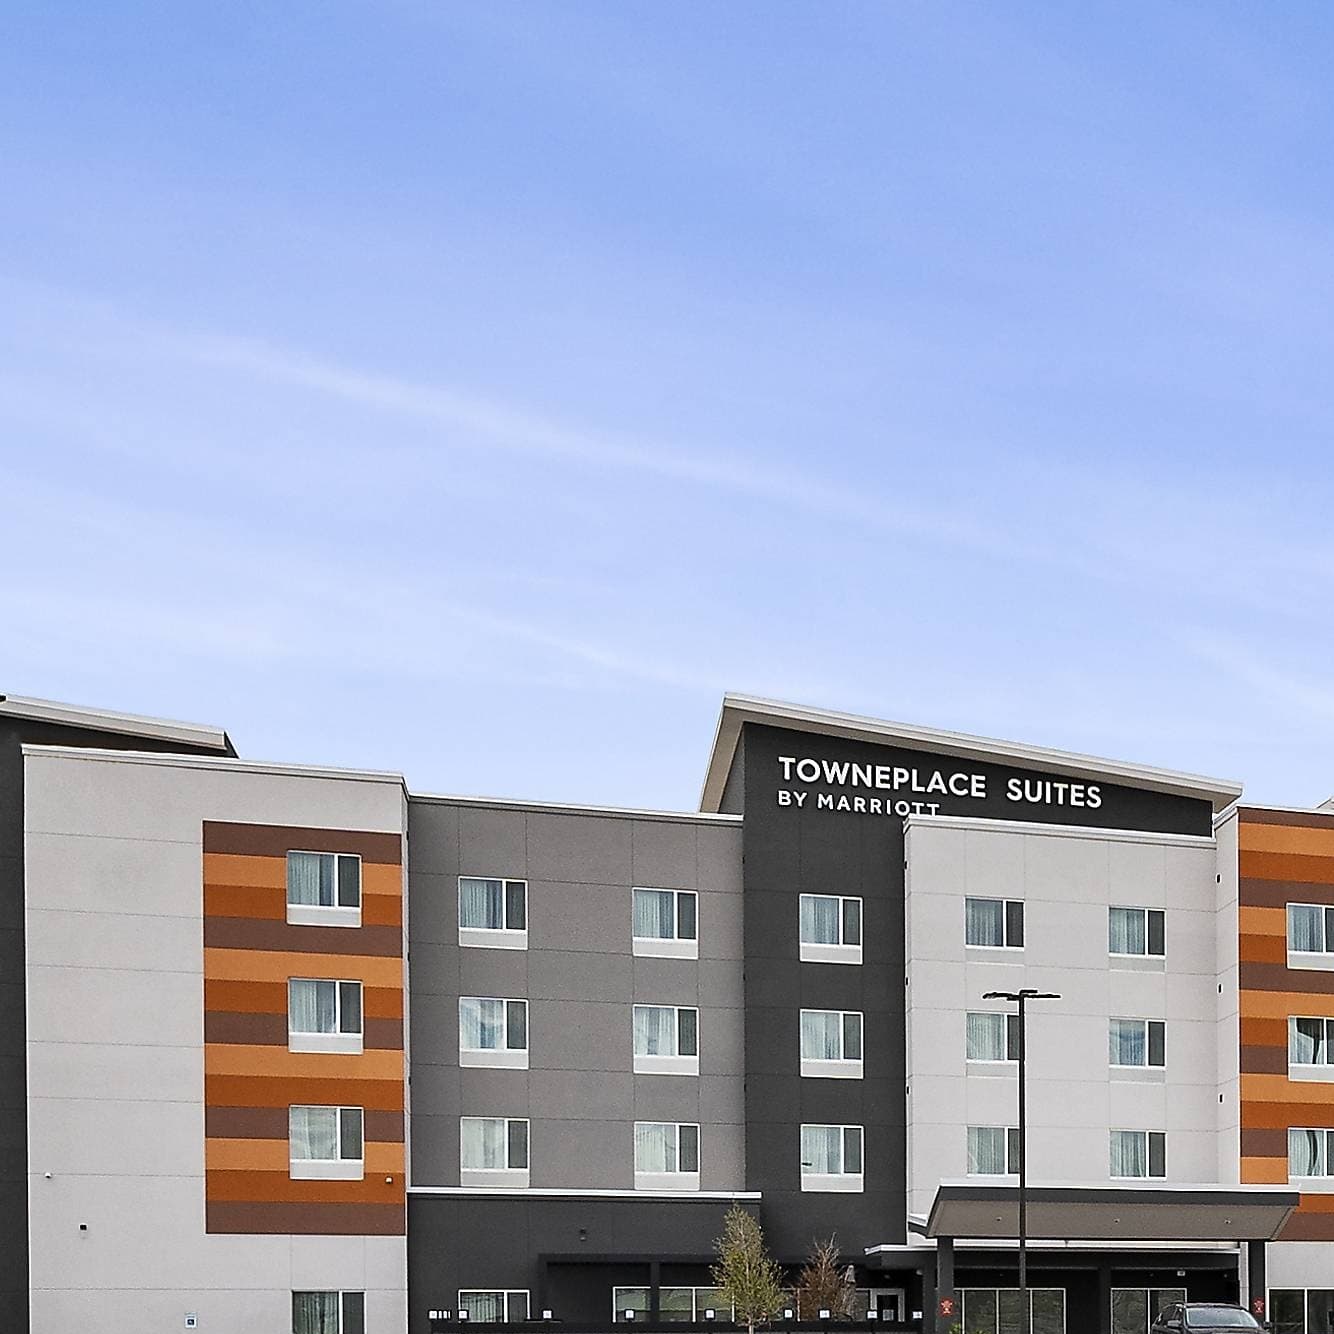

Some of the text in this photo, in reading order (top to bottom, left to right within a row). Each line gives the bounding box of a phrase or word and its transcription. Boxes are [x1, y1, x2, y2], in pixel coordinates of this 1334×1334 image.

[778, 756, 1101, 808] TOWNEPLACE SUITES
[777, 790, 940, 816] BY MARRIOTT
